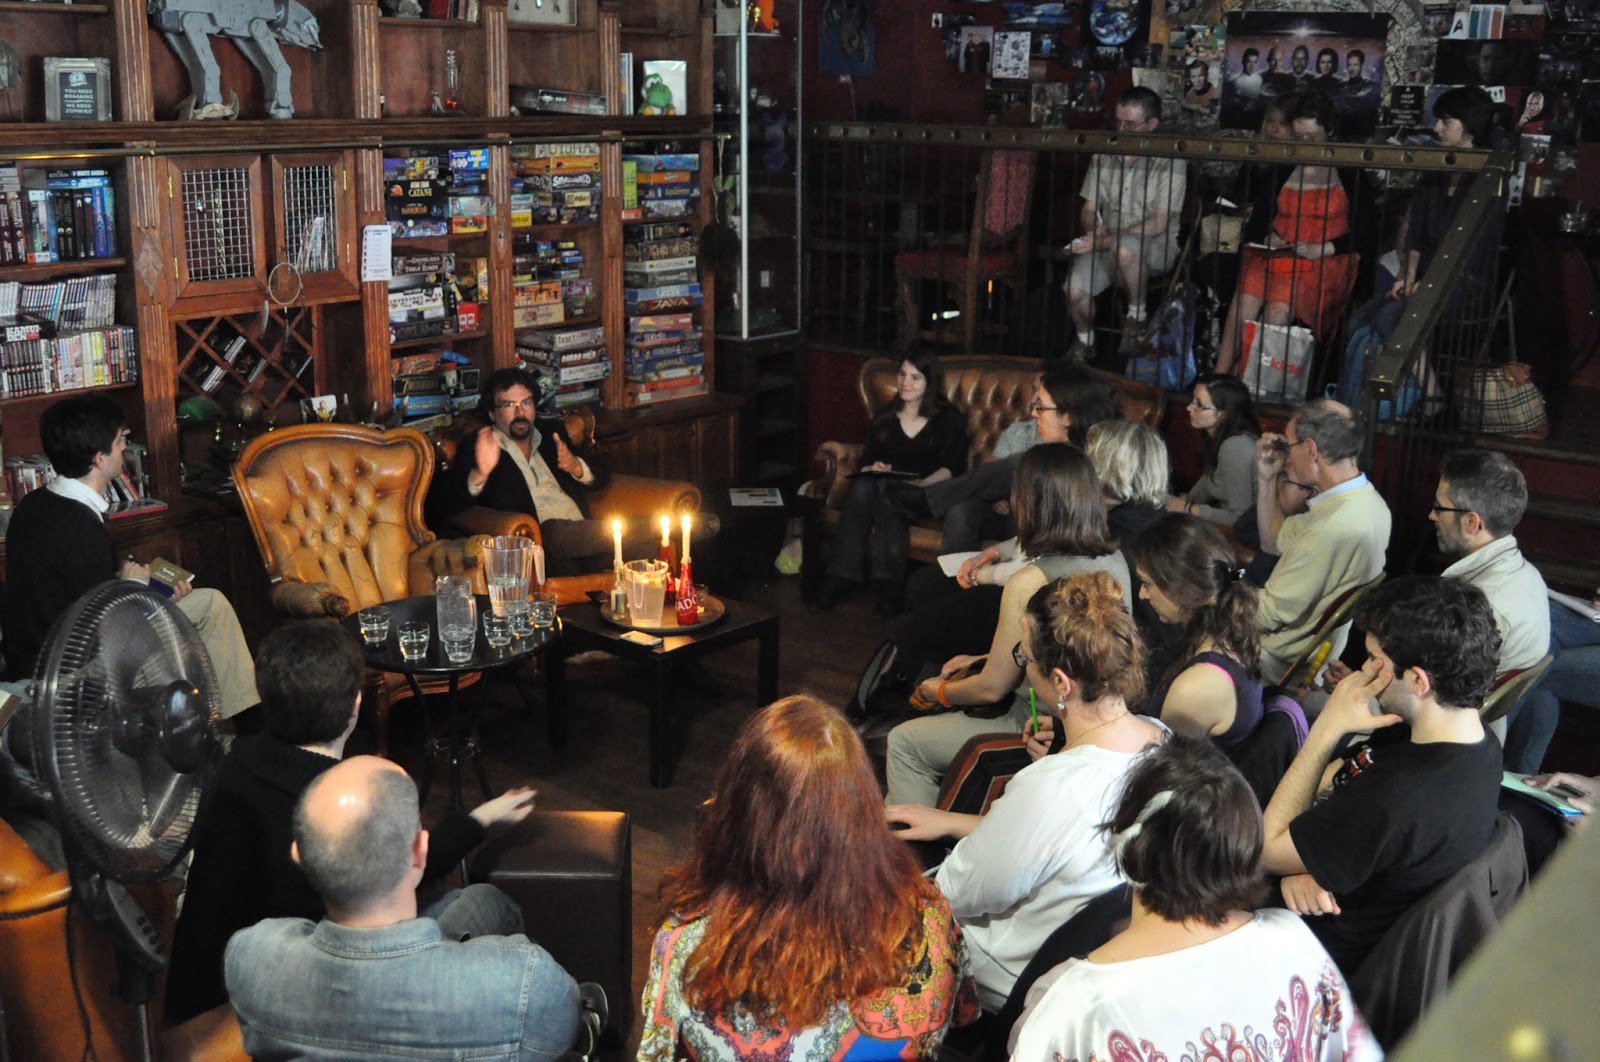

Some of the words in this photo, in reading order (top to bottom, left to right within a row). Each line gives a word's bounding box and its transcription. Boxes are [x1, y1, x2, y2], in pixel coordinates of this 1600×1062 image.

[408, 188, 433, 197] CATANE
[405, 265, 421, 273] TABLE
[649, 297, 689, 310] JAVA
[676, 594, 697, 611] ADO
